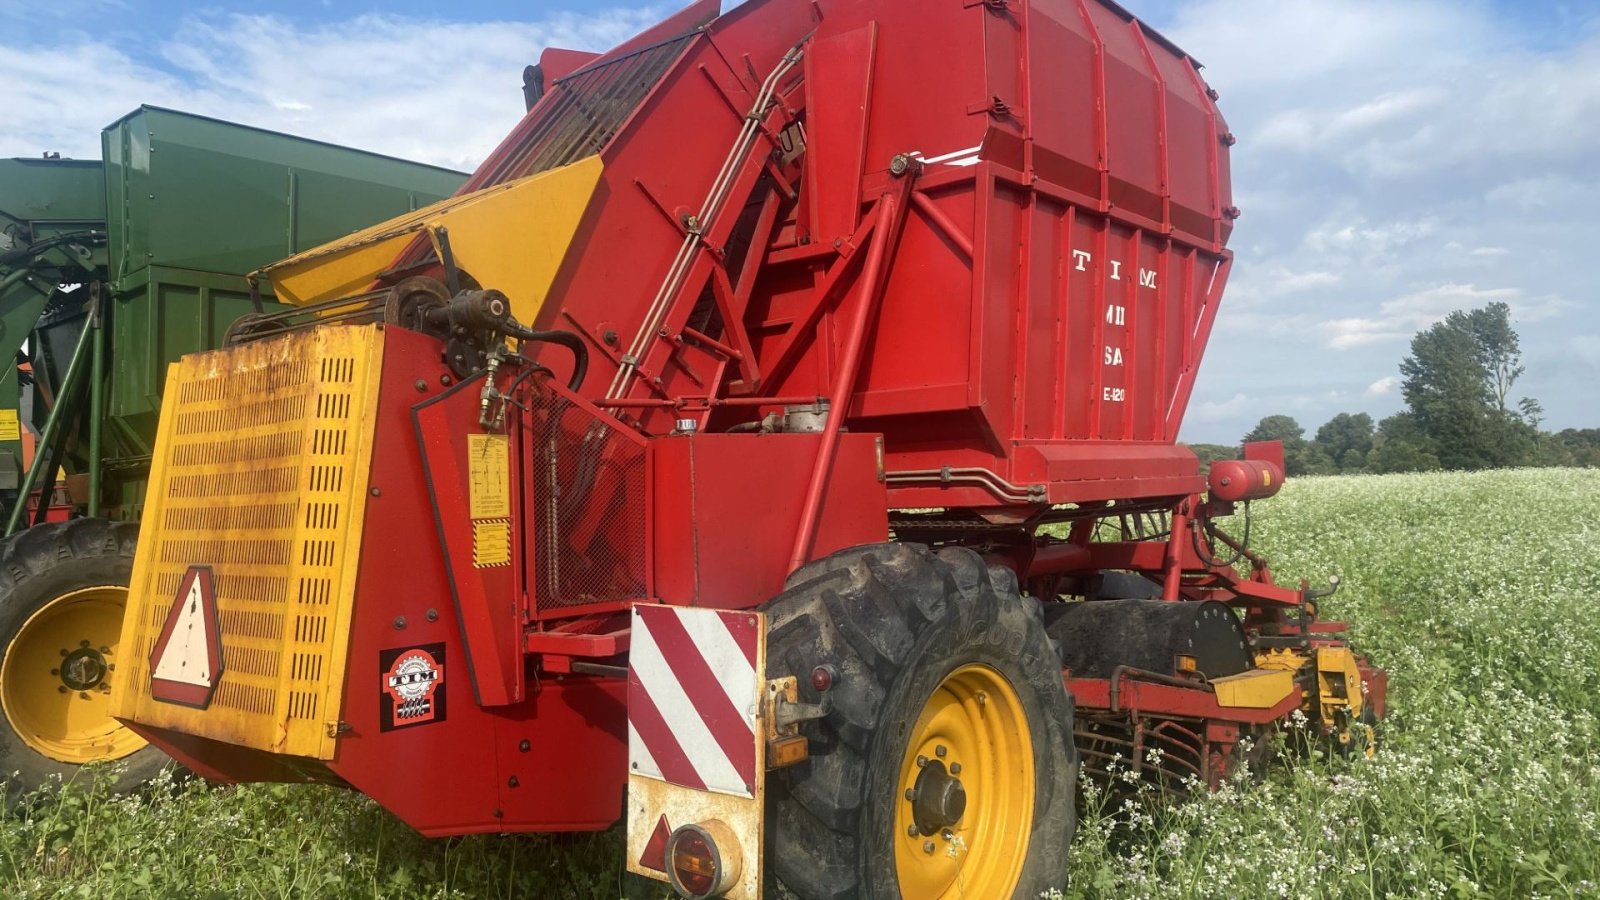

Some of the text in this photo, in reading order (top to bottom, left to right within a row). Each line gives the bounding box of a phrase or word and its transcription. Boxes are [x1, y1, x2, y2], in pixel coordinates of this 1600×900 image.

[1104, 345, 1124, 367] SA
[1103, 387, 1125, 402] E-120
[391, 670, 436, 687] TIM
